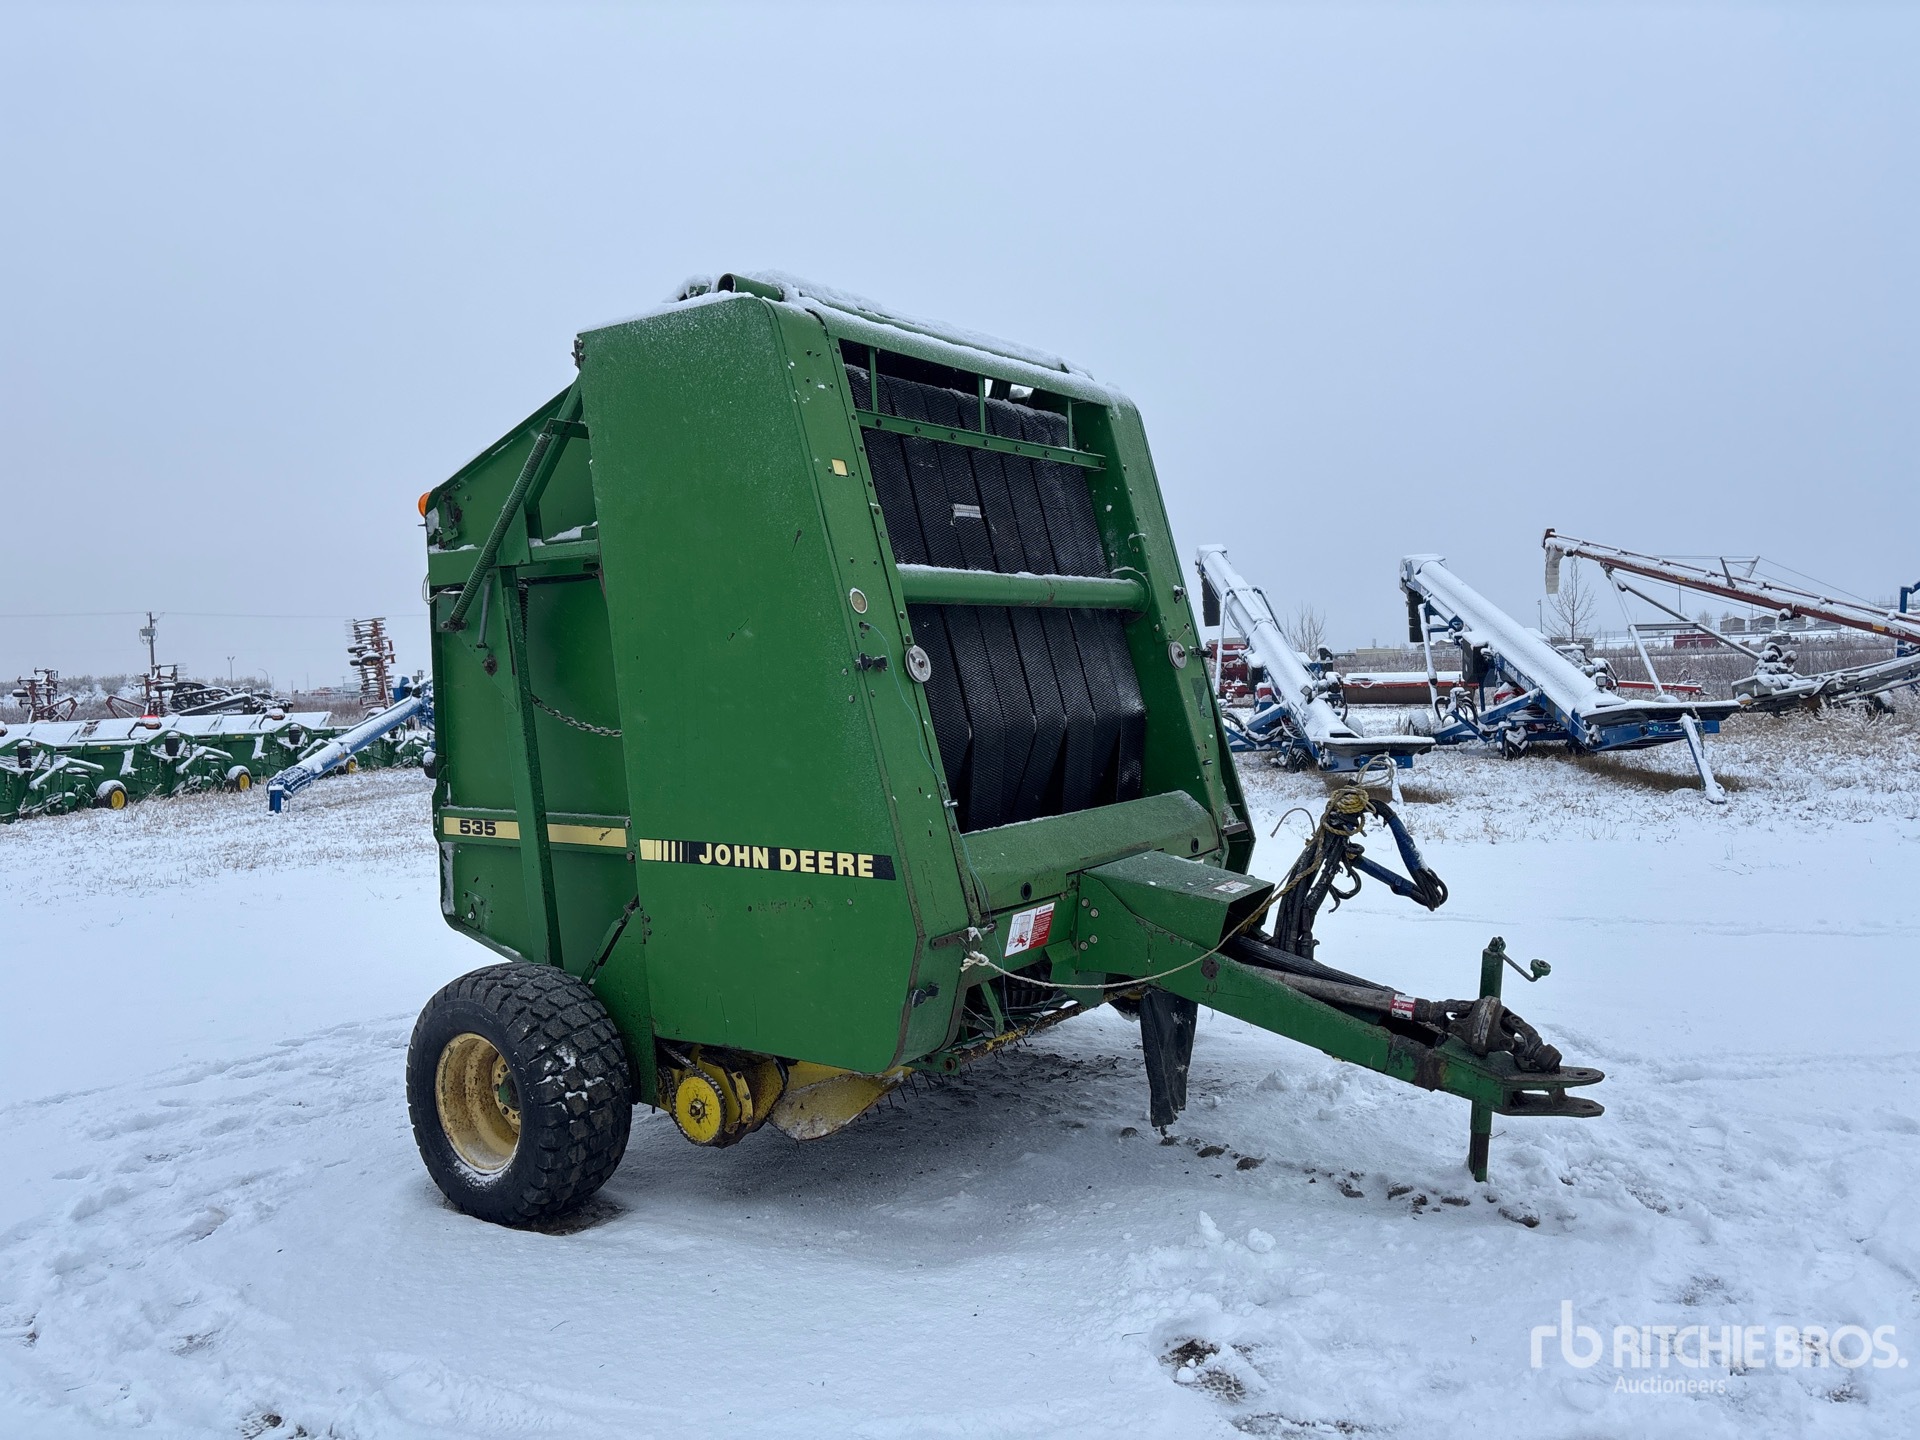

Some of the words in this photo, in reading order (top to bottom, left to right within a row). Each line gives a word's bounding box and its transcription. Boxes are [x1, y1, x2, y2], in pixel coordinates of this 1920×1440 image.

[460, 819, 497, 836] 535
[699, 843, 769, 870] JOHN
[779, 848, 874, 878] DEERE
